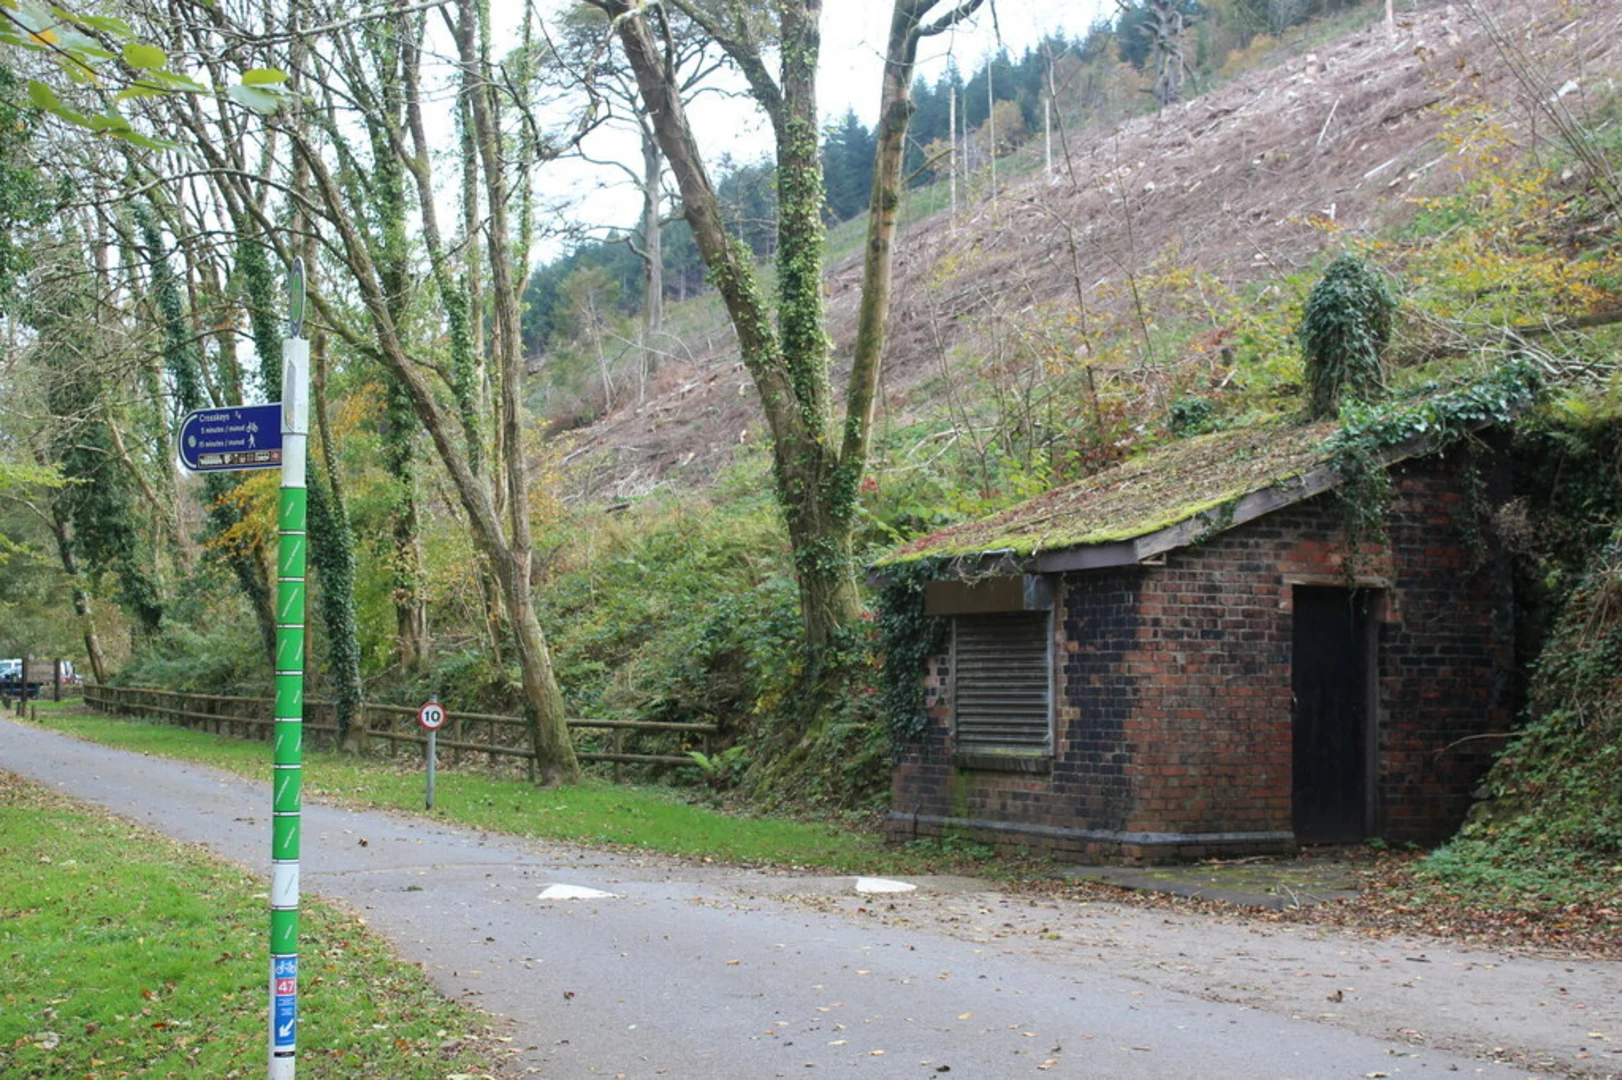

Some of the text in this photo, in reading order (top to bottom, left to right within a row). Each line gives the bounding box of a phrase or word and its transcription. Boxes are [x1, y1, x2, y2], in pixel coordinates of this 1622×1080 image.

[199, 413, 230, 423] Crosskeys
[205, 426, 224, 434] minutes
[229, 424, 245, 432] munud
[228, 438, 245, 446] munud
[424, 710, 441, 723] 10
[278, 980, 294, 992] 47
